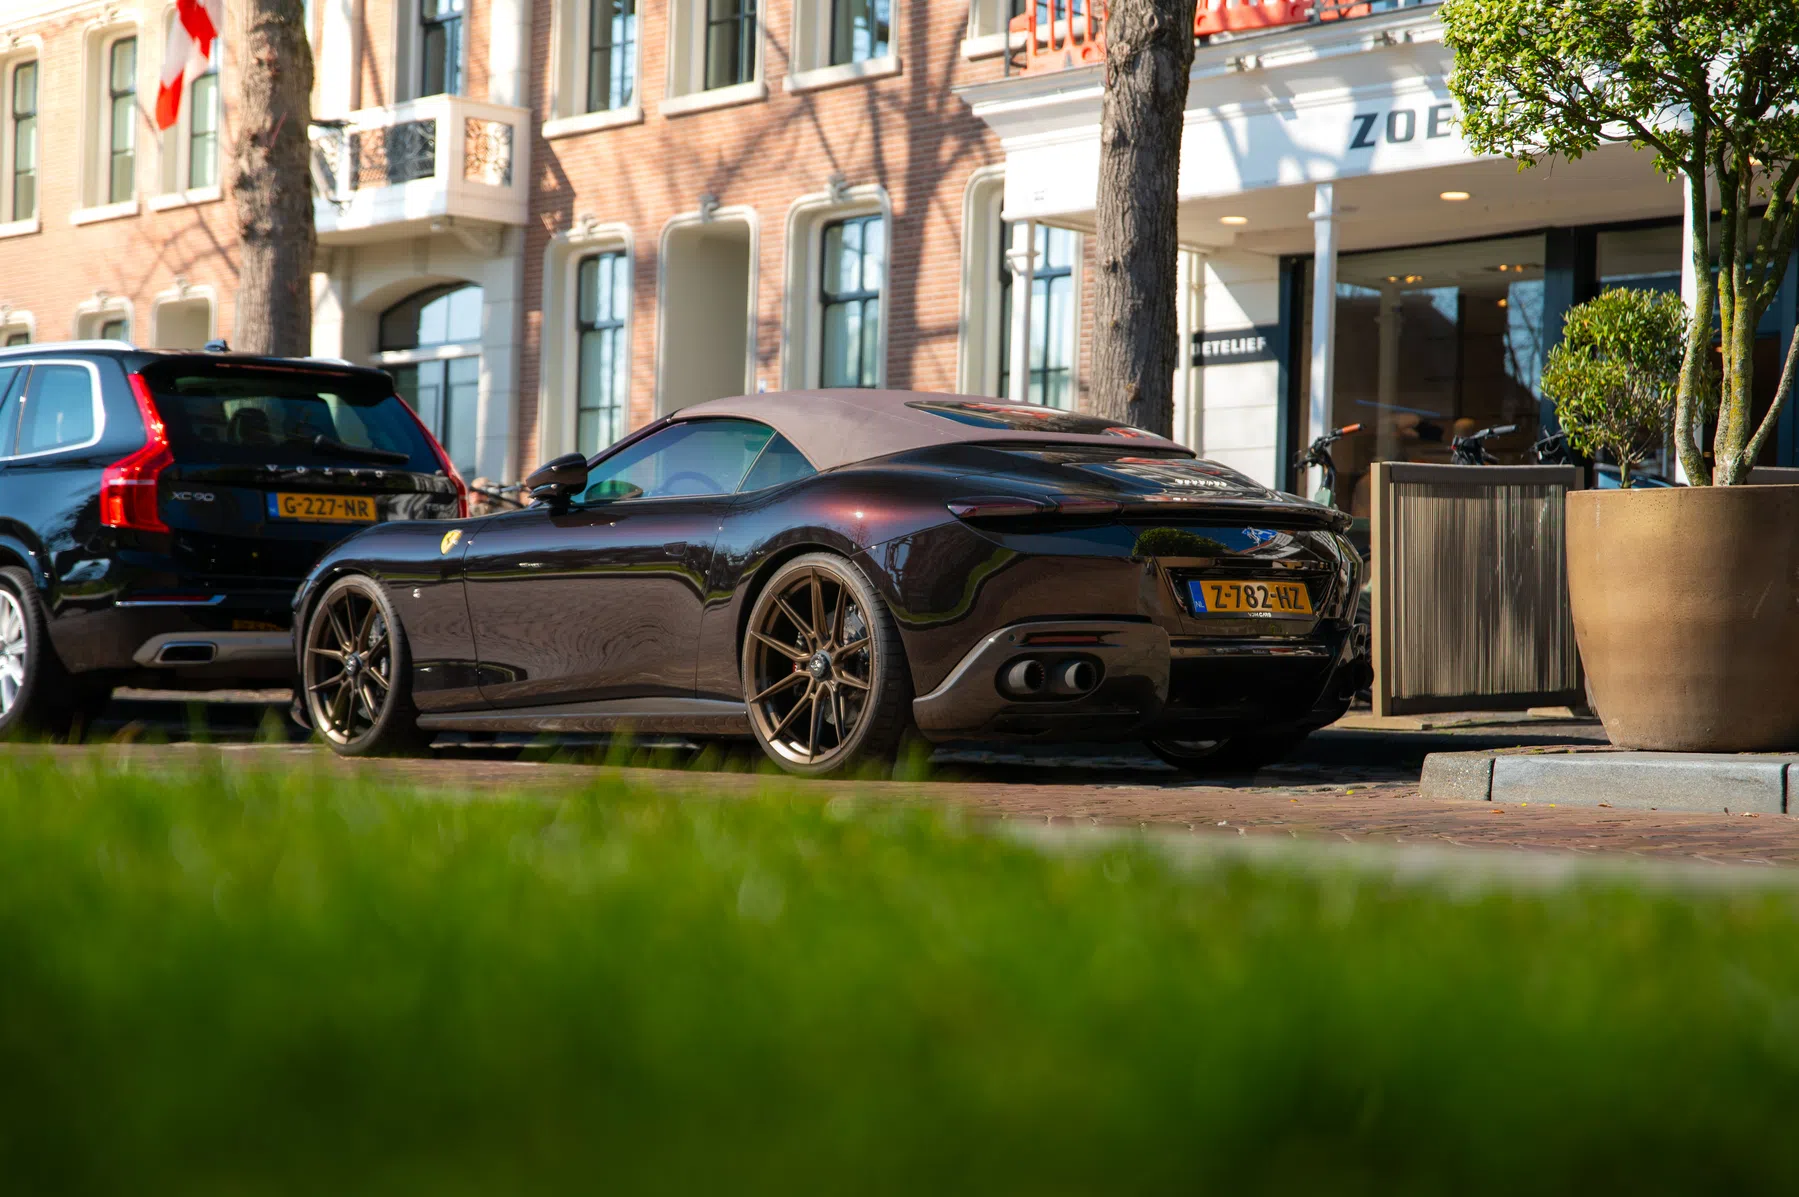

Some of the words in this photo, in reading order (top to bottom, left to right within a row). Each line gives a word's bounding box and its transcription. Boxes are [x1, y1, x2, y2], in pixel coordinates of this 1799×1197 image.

[1350, 103, 1453, 149] ZOE
[265, 464, 384, 478] VOLVO
[284, 497, 369, 517] G-227-NR
[1211, 585, 1305, 609] Z-782-HZ
